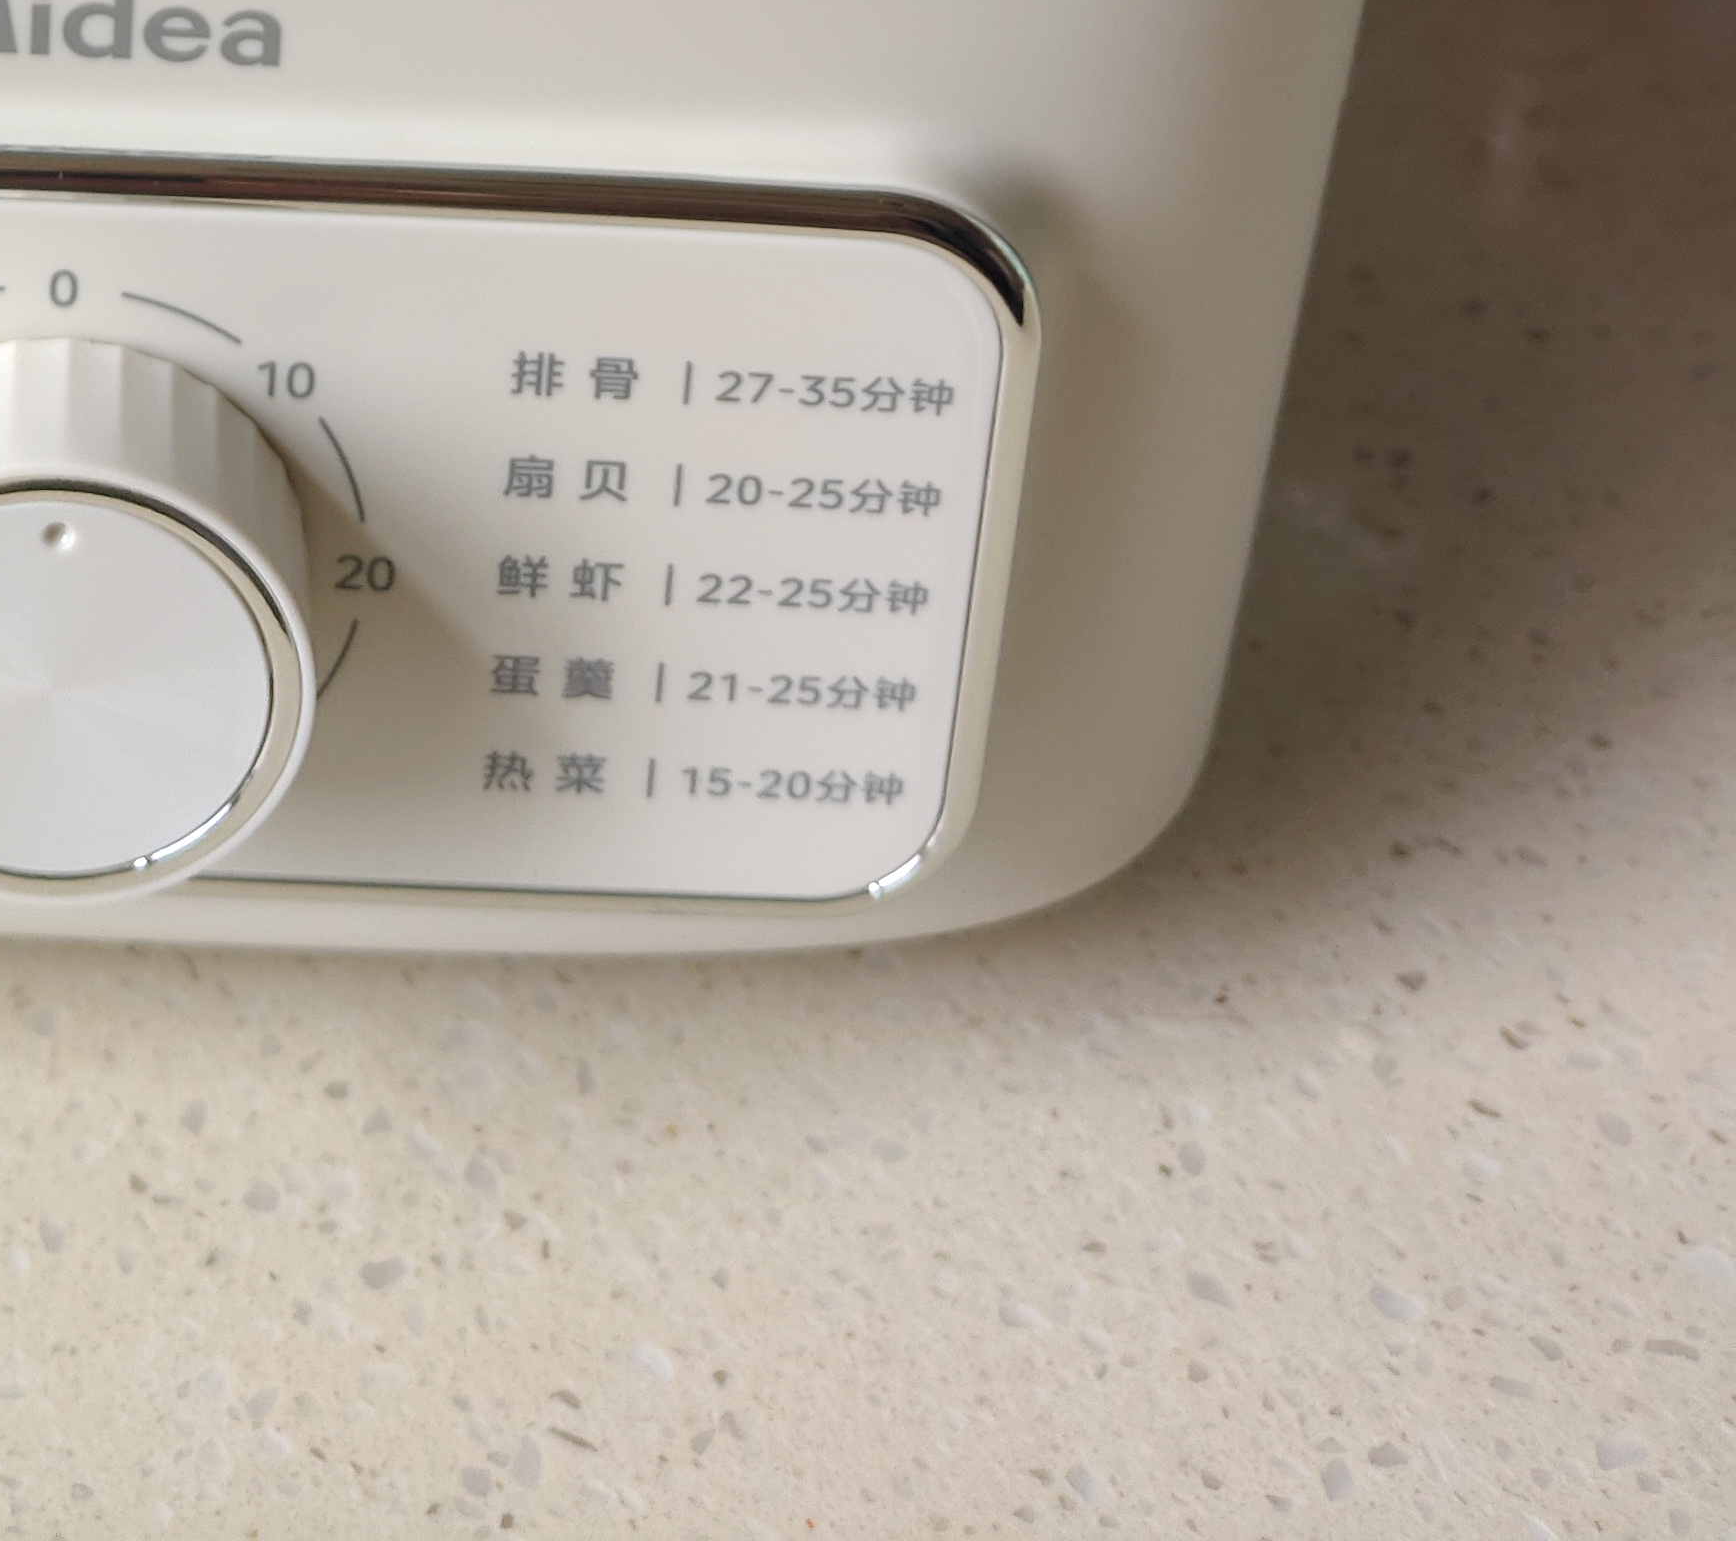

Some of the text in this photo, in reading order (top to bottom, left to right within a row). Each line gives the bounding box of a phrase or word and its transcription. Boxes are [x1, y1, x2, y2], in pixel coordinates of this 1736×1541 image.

[49, 270, 78, 308] 0
[259, 361, 315, 399] 10
[715, 371, 953, 416] 27-35分钟
[706, 474, 940, 517] 20-25分钟
[334, 554, 395, 592] 20
[696, 574, 928, 615] 22-25分钟
[687, 671, 915, 711] 21-25分钟
[683, 767, 903, 804] 15-20分钟
